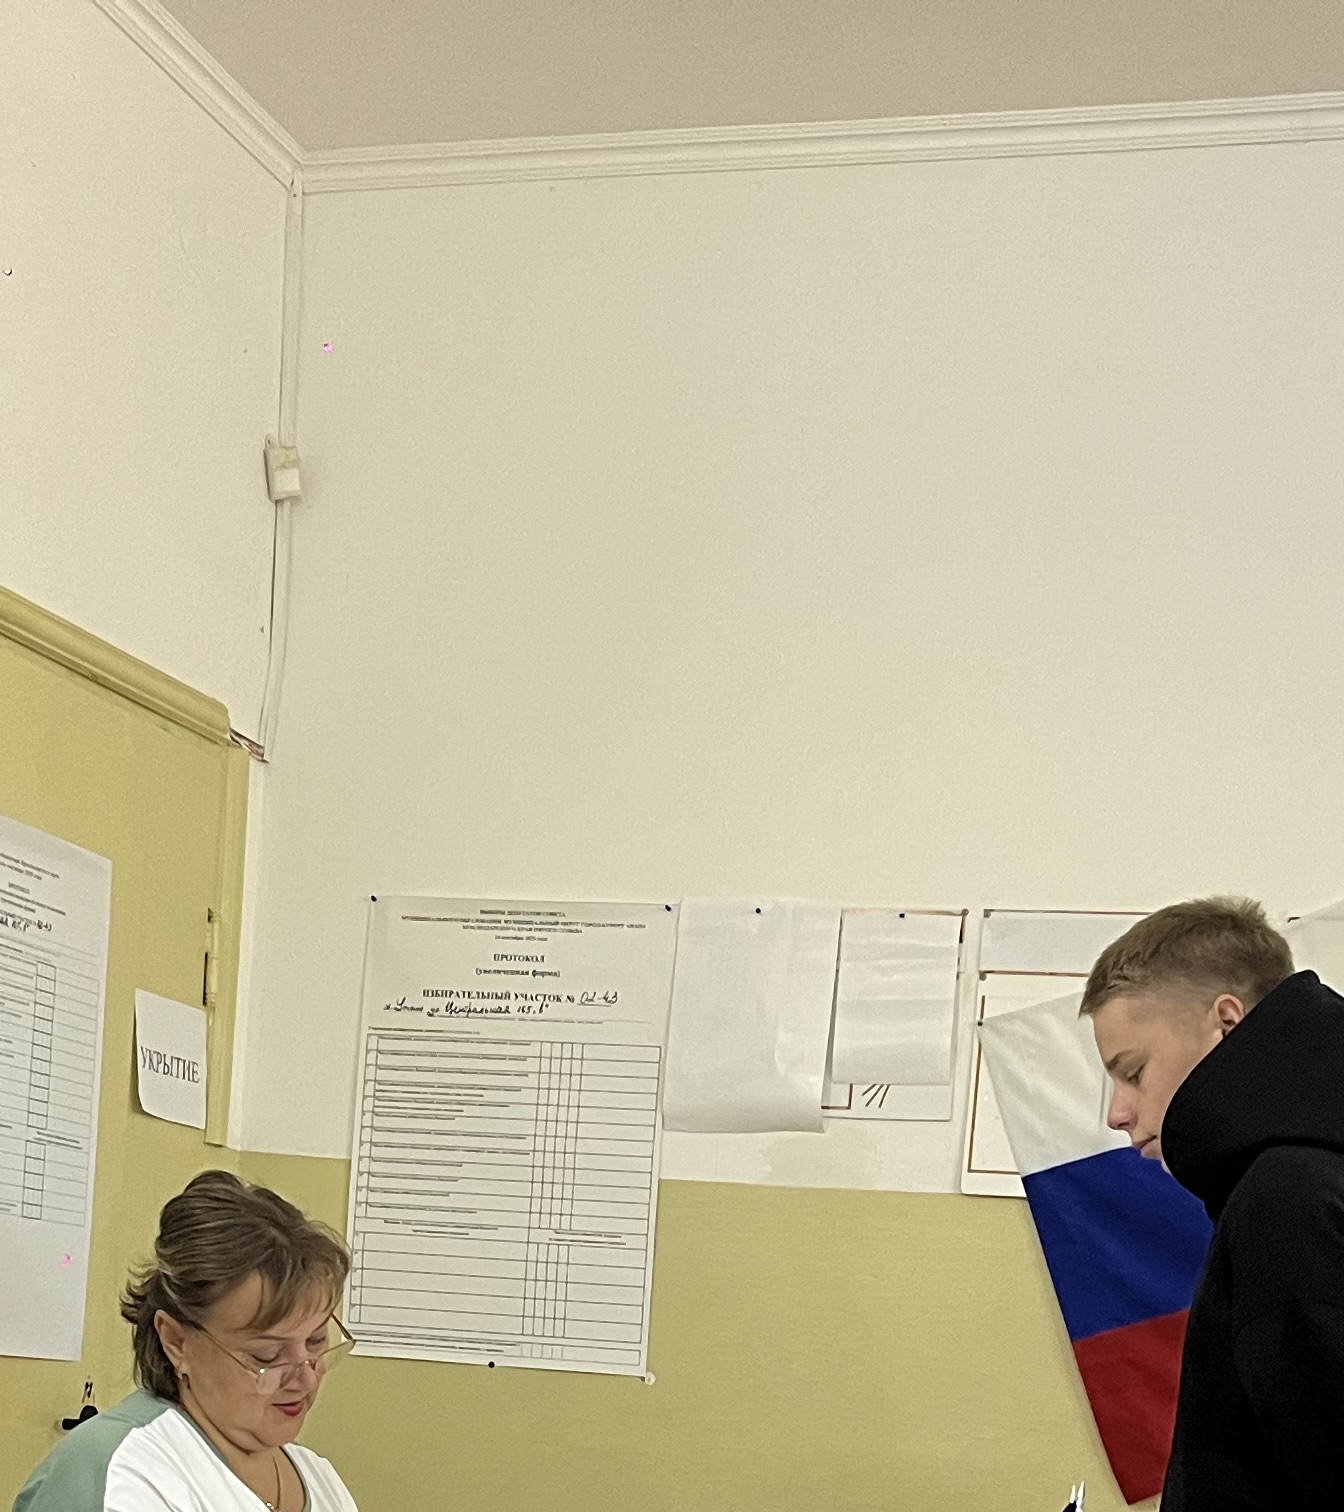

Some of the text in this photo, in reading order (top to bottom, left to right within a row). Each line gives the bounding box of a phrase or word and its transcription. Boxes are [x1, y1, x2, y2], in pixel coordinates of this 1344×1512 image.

[493, 953, 545, 963] ПРОТОКОЛ
[422, 989, 511, 1001] ИЗБИРАТЕЛЬНЫЙ
[514, 992, 563, 1004] УЧАСТОК
[139, 1045, 201, 1084] УКРЫТИЕ
